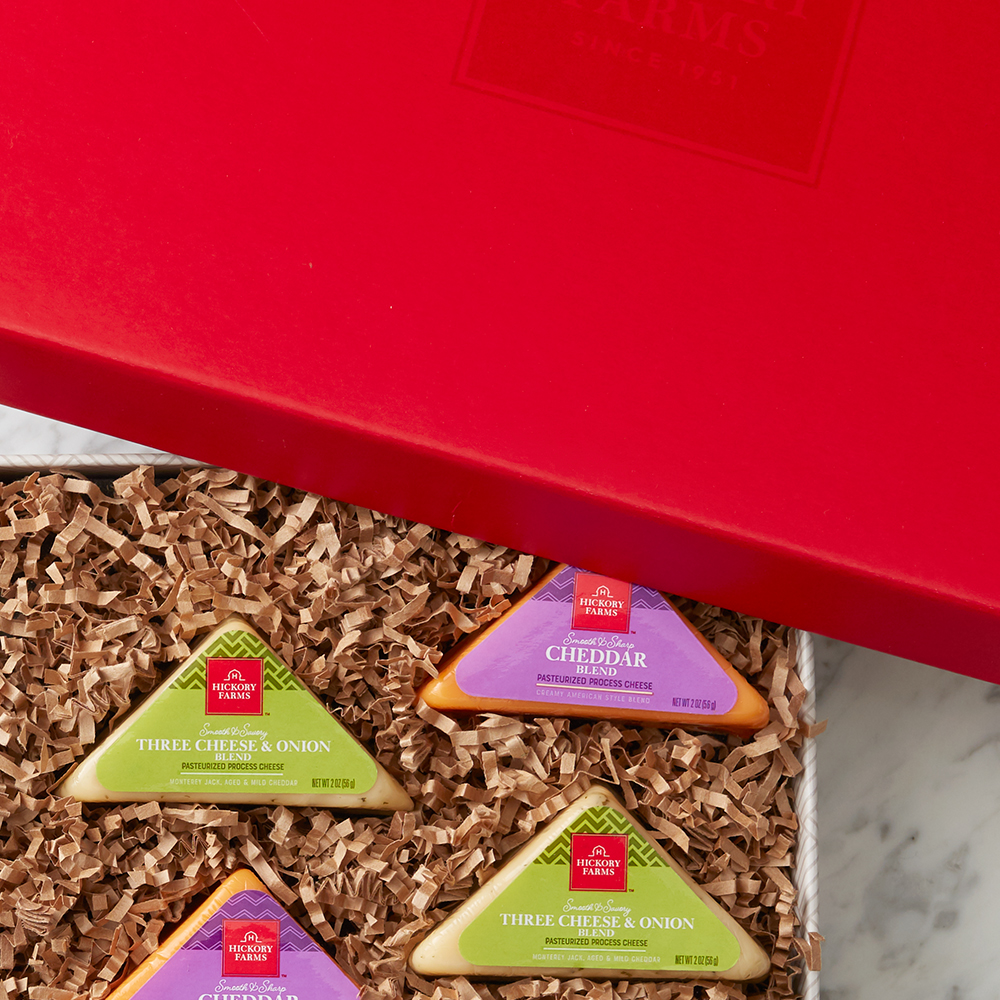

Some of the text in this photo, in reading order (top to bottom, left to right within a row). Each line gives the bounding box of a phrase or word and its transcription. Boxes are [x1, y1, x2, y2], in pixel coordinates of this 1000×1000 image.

[570, 31, 739, 90] SINCE 1951
[580, 598, 625, 609] HICKORY
[585, 607, 618, 616] FARMS
[563, 632, 635, 652] Smooth Sharp
[546, 645, 648, 668] CHEDDAR
[576, 665, 617, 676] BLEND
[212, 682, 257, 691] HICKORY
[537, 674, 653, 690] PASTEURIZED PROCESS CHEESE
[218, 691, 251, 700] FARMS
[567, 691, 602, 700] AMERICAN
[605, 694, 626, 702] STYLE
[628, 696, 650, 704] BLEND
[199, 723, 268, 740] Smooth Savory
[136, 739, 331, 752] THREE CHEESE & ONION
[215, 753, 252, 761] BLEND
[576, 859, 621, 868] HICKORY
[583, 867, 615, 876] FARMS
[563, 898, 631, 917] Smooth Savory
[500, 913, 695, 930] THREE CHEESE & ONION
[578, 929, 615, 938] BLEND
[545, 937, 648, 947] PASTEURIZED PROCESS CHEESE
[229, 944, 273, 953] HICKORY
[235, 953, 267, 961] FARMS
[675, 955, 684, 964] NET
[685, 956, 693, 964] WT
[694, 956, 697, 965] 2
[698, 956, 705, 965] OZ
[215, 979, 286, 995] Smooth Sharp
